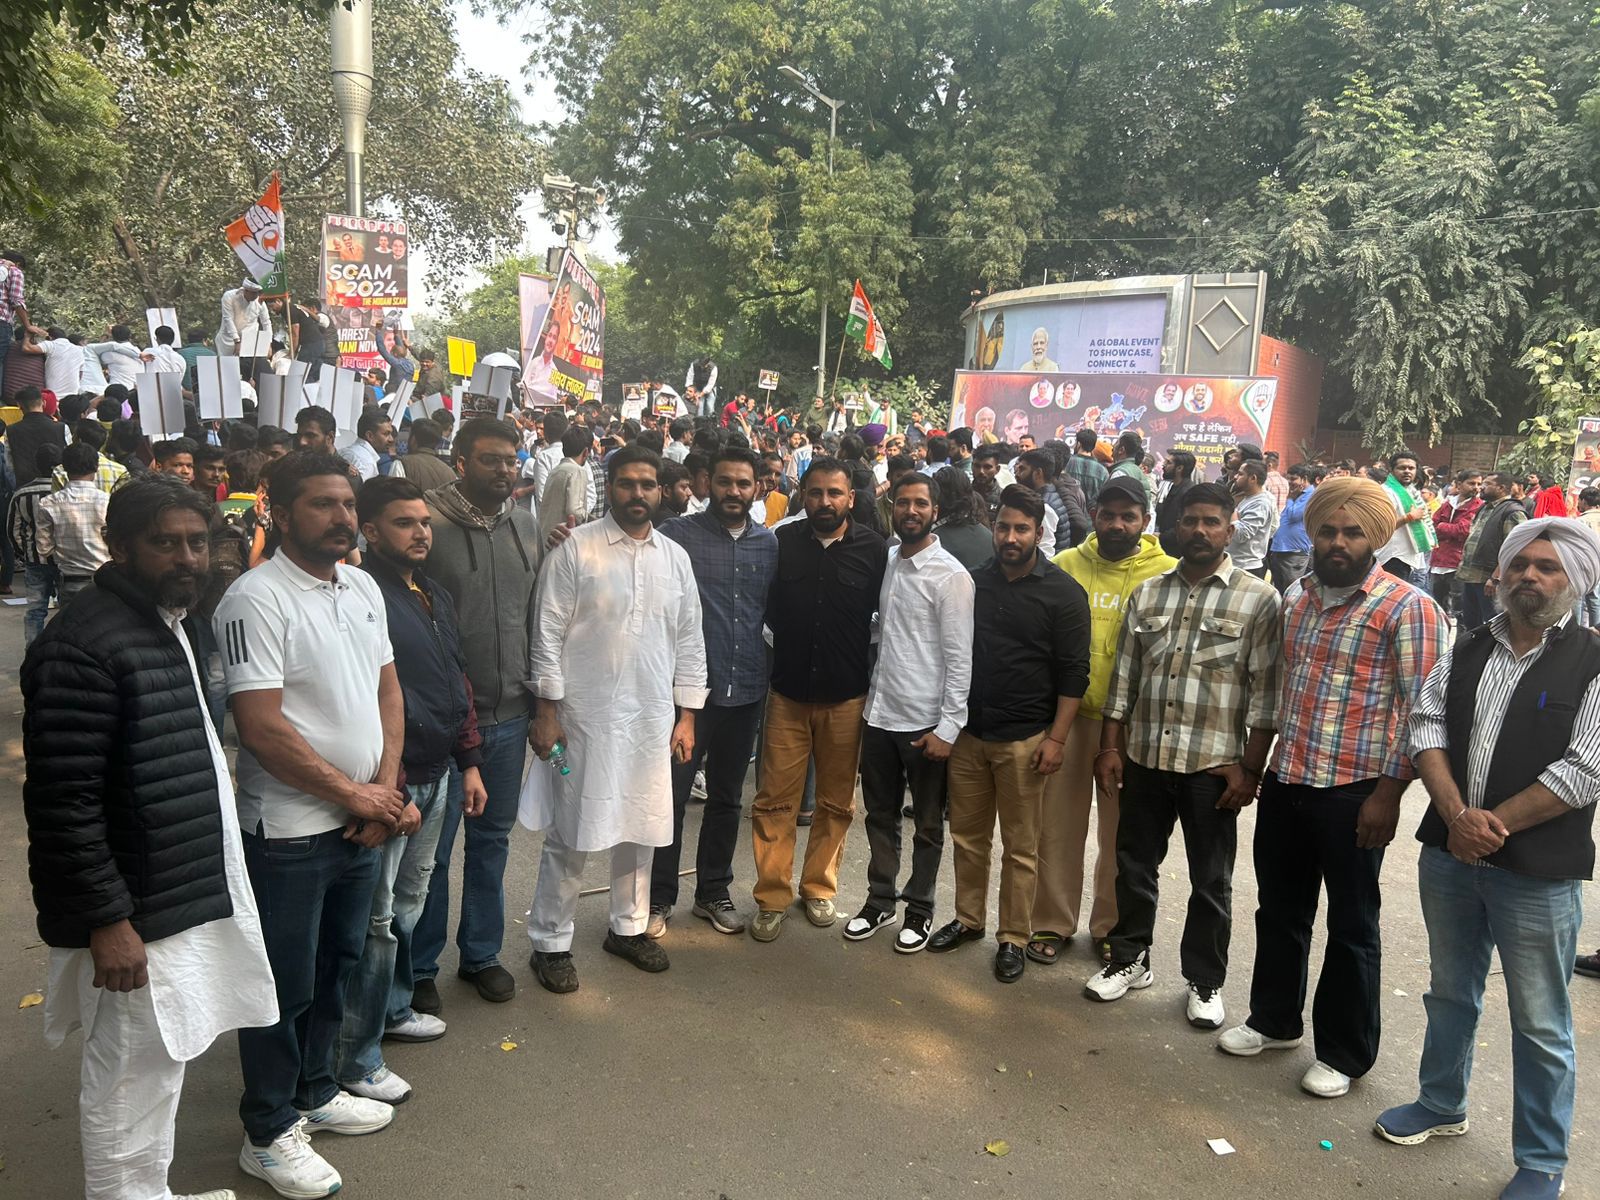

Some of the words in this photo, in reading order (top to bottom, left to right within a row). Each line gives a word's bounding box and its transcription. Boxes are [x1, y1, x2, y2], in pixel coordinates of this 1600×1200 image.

[329, 263, 393, 280] SCAM
[345, 280, 399, 297] 2024
[571, 301, 600, 332] SCAM
[575, 328, 601, 356] 2024
[1089, 339, 1095, 347] A
[1097, 338, 1129, 347] GLOBAL
[1131, 337, 1160, 346] EVENT
[1088, 349, 1099, 357] TO
[1100, 348, 1153, 357] SHOWCASE,
[1087, 359, 1128, 368] CONNECT
[1129, 359, 1136, 368] &
[1182, 423, 1197, 432] एक
[1198, 421, 1205, 433] है
[1206, 421, 1232, 433] लेकिन
[1173, 433, 1187, 441] अब
[1188, 433, 1219, 443] SAFE
